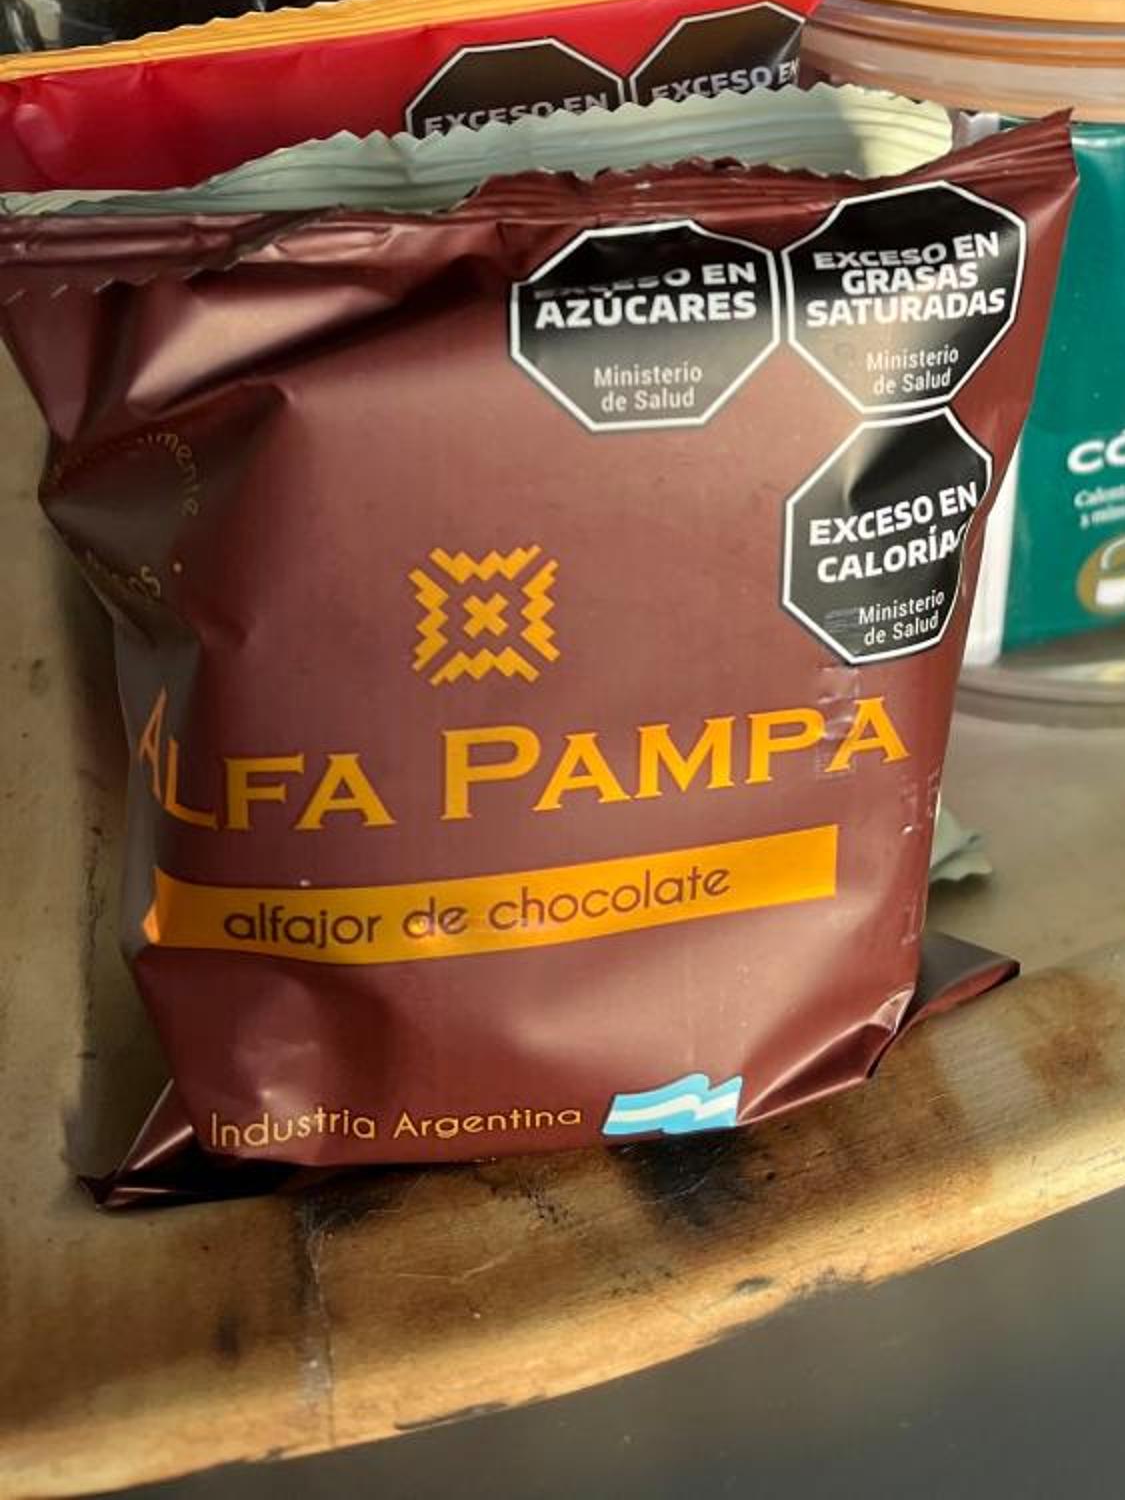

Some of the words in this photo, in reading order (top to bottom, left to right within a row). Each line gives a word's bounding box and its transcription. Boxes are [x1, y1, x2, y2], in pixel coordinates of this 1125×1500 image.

[813, 243, 947, 270] EXCESO
[952, 231, 1000, 260] EN
[702, 262, 756, 285] EN
[841, 261, 979, 296] GRASAS
[535, 290, 757, 329] AZÚCARES
[806, 288, 1006, 328] SATURADAS
[593, 362, 703, 387] Ministerio
[866, 344, 959, 372] Ministerio
[601, 392, 627, 412] de
[634, 387, 694, 411] Salud
[874, 376, 897, 395] de
[901, 368, 951, 393] Salud
[809, 495, 934, 546] EXCESO
[938, 481, 977, 517] EN
[859, 589, 945, 625] Ministerio
[864, 627, 887, 645] de
[892, 612, 939, 640] Salud
[439, 696, 911, 821] PAMPA
[223, 895, 381, 950] alfajor
[401, 896, 468, 940] de
[490, 863, 730, 931] chocolate
[211, 1105, 376, 1150] Industria
[394, 1106, 582, 1141] Argentina
